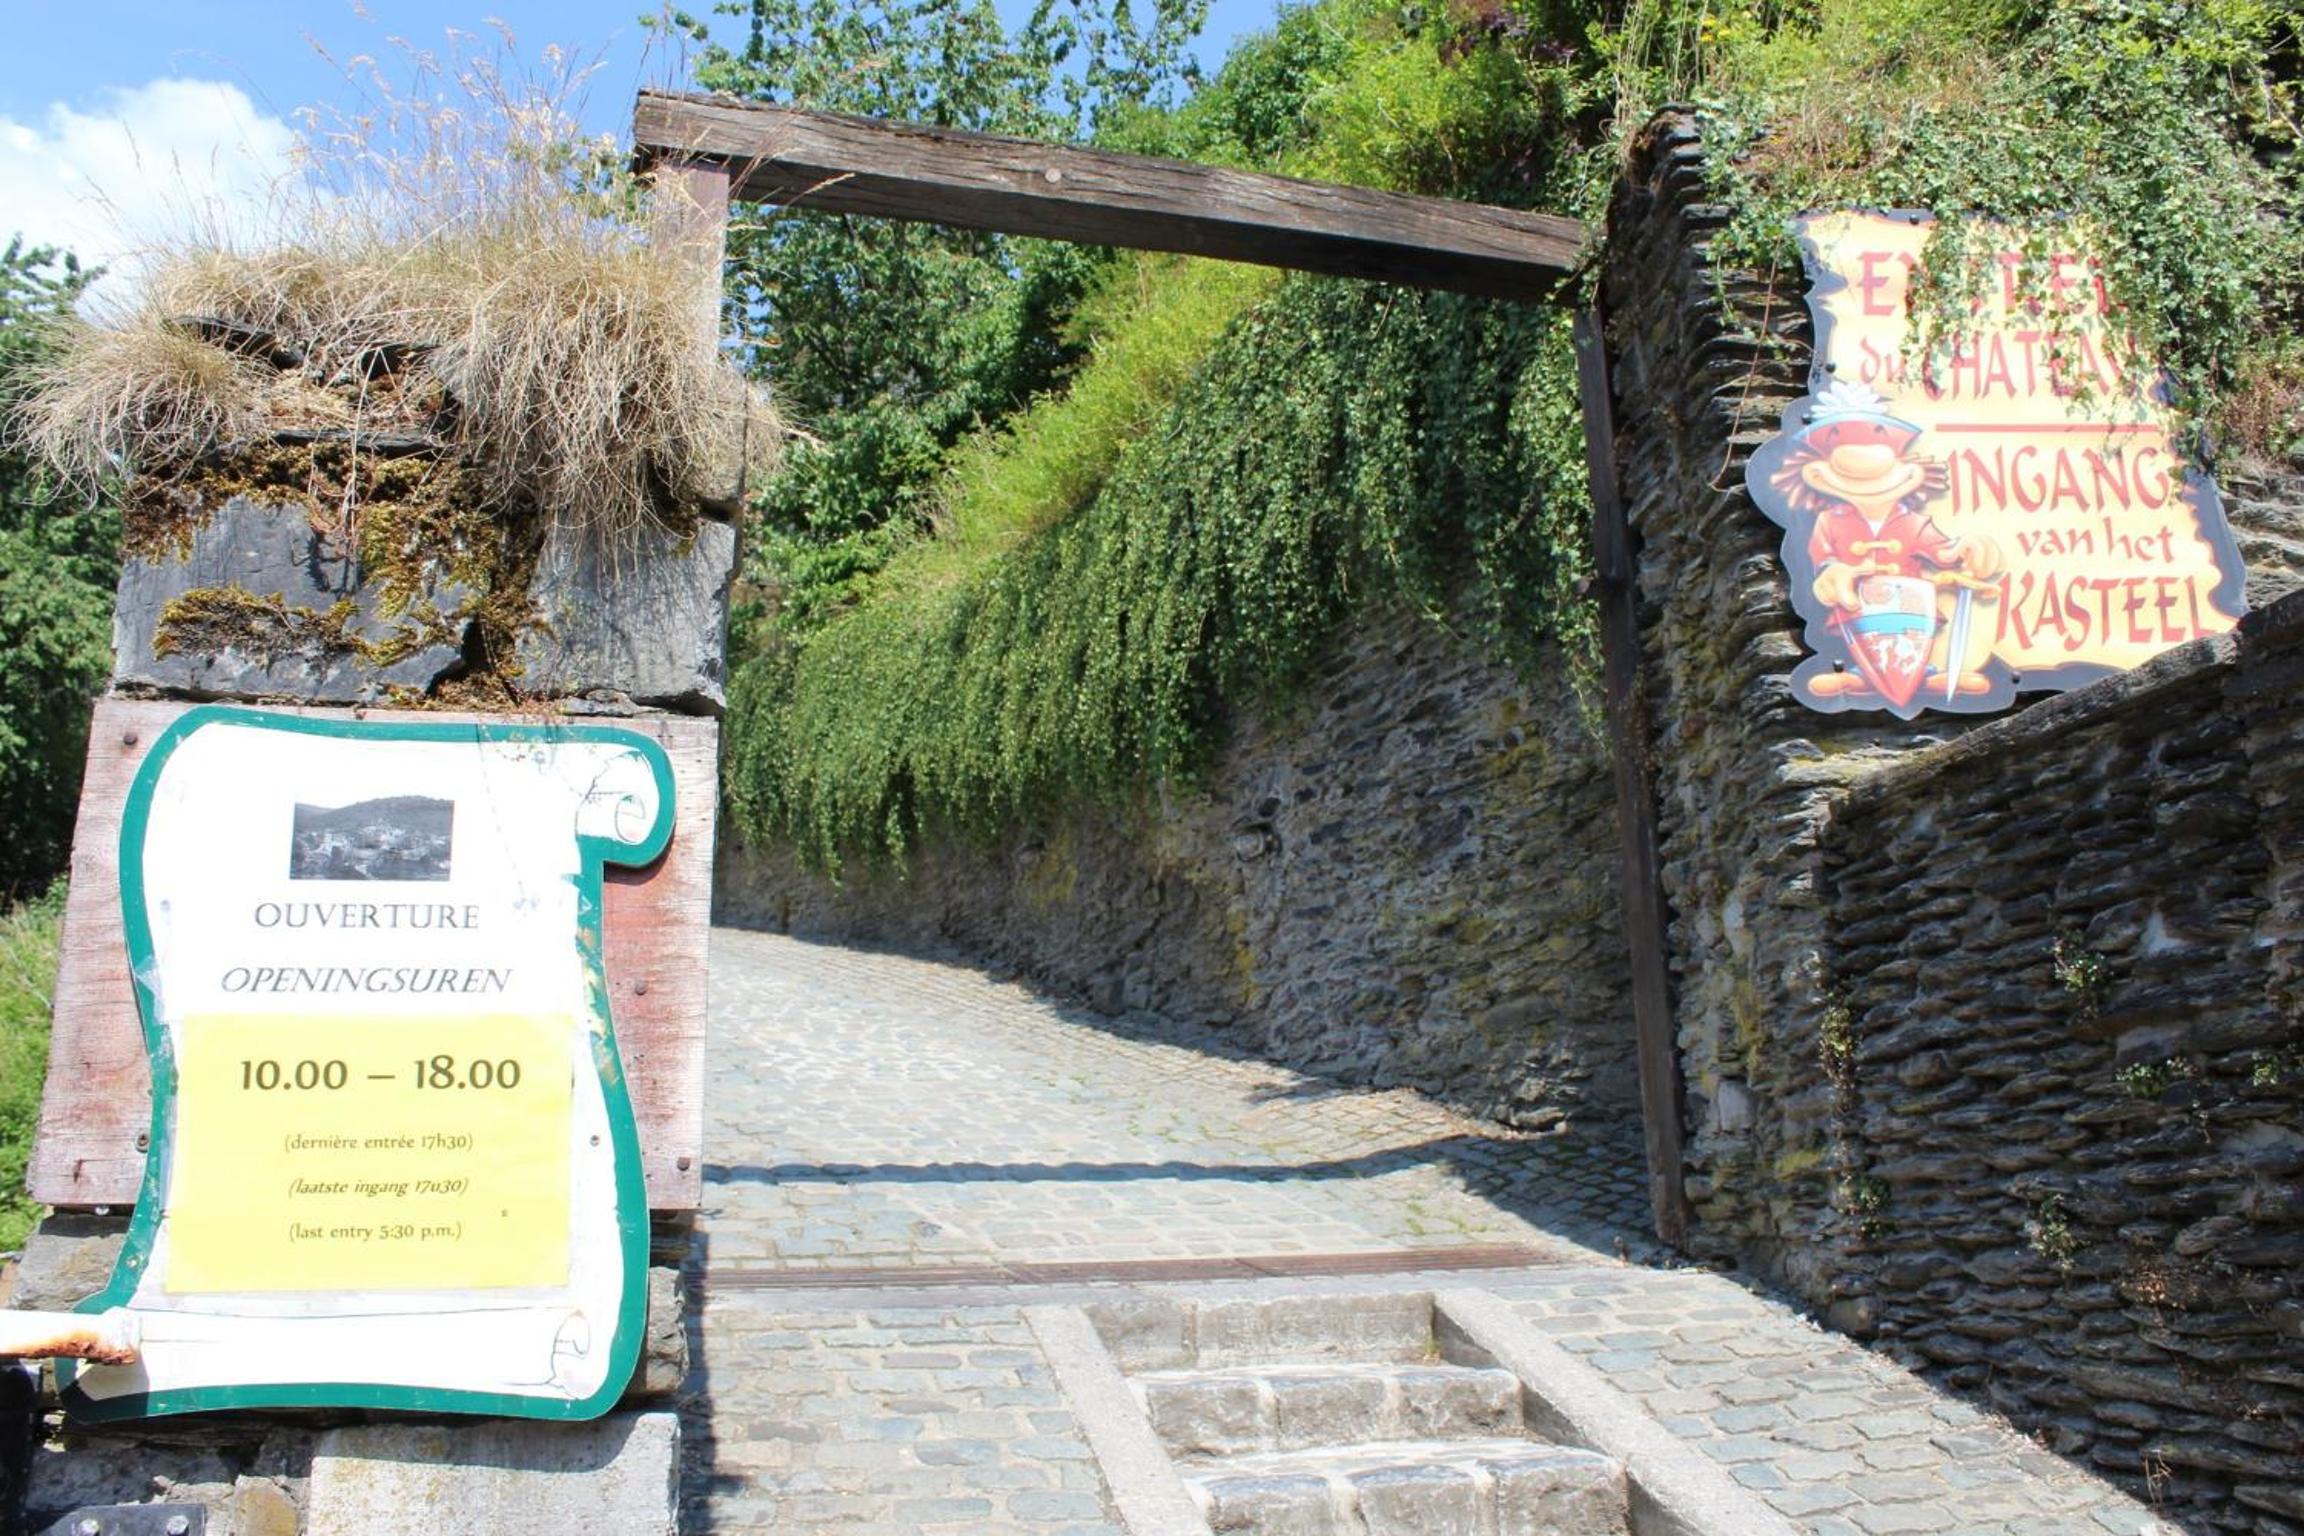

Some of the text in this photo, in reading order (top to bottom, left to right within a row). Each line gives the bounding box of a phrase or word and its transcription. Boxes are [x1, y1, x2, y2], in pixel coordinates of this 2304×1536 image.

[1947, 445, 2169, 516] INGANG
[2016, 516, 2174, 563] van het
[1995, 570, 2217, 651] KASTEEL
[254, 902, 480, 929] OUVERTURE
[220, 966, 512, 993] OPENINGSUREN
[240, 1059, 348, 1090] 10.00
[414, 1054, 521, 1090] 18.00
[284, 1133, 474, 1152] (dernière entrée 17h30)
[288, 1177, 469, 1198] (laatste ingang 17u30)
[289, 1221, 462, 1242] (last entry 5:30 p.m.)
